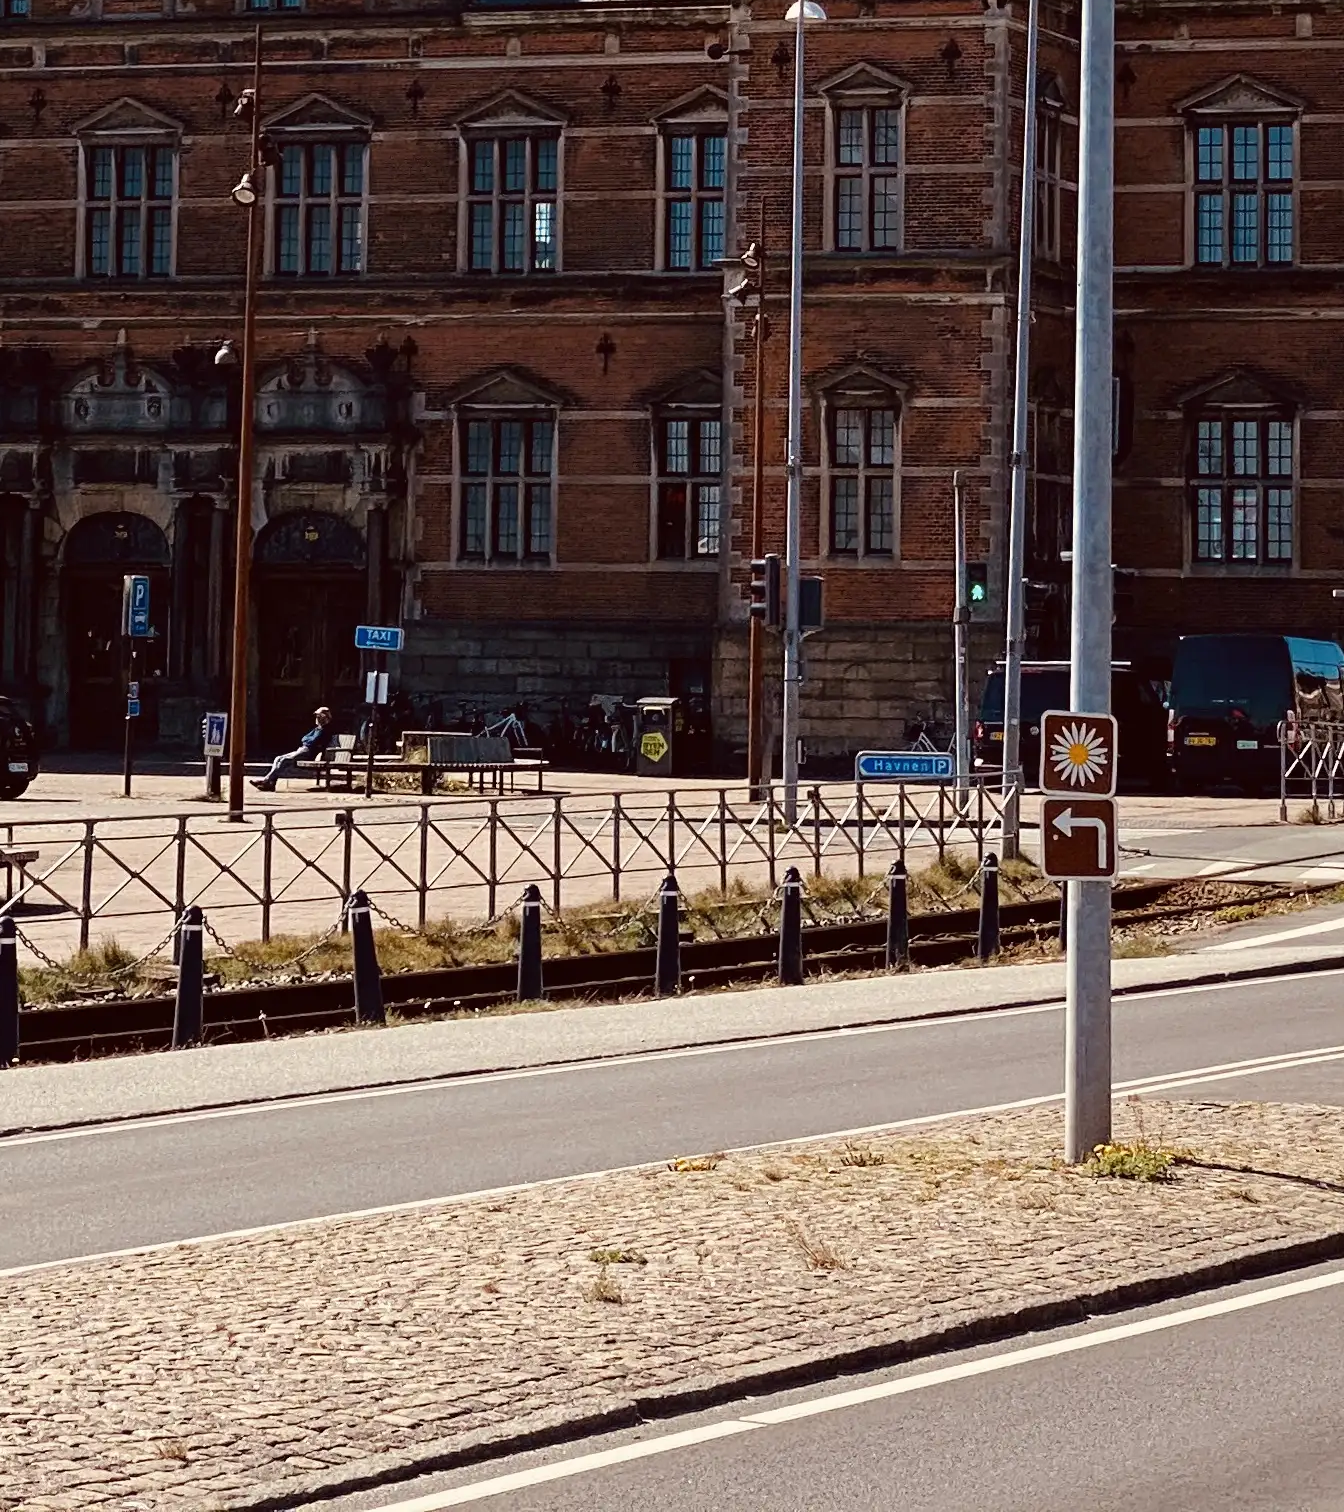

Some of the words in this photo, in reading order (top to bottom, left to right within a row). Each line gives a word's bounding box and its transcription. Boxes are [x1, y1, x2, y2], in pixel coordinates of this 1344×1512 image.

[135, 584, 145, 607] P
[366, 629, 391, 641] TAXI
[874, 760, 928, 771] Havnen
[937, 760, 947, 772] P
